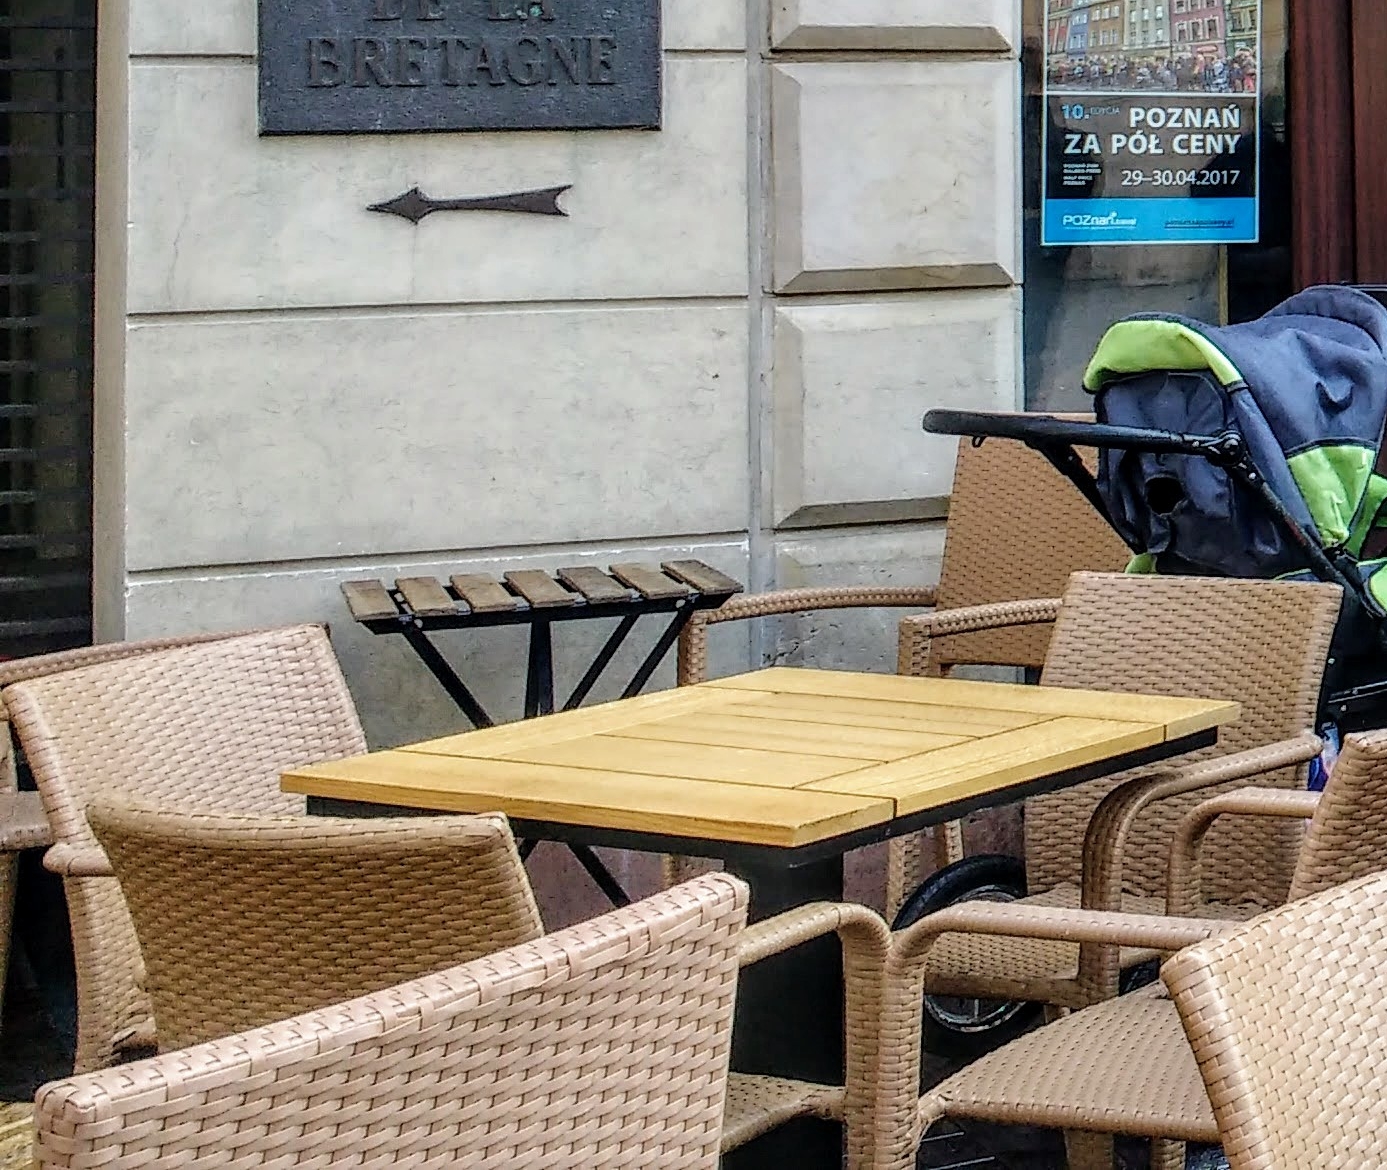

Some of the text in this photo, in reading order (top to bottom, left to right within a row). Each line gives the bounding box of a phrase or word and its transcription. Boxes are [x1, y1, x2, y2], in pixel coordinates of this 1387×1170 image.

[305, 35, 618, 88] BRETAGNE
[1129, 103, 1241, 129] POZNAŃ
[1063, 130, 1242, 155] ZA PÓŁ CENY
